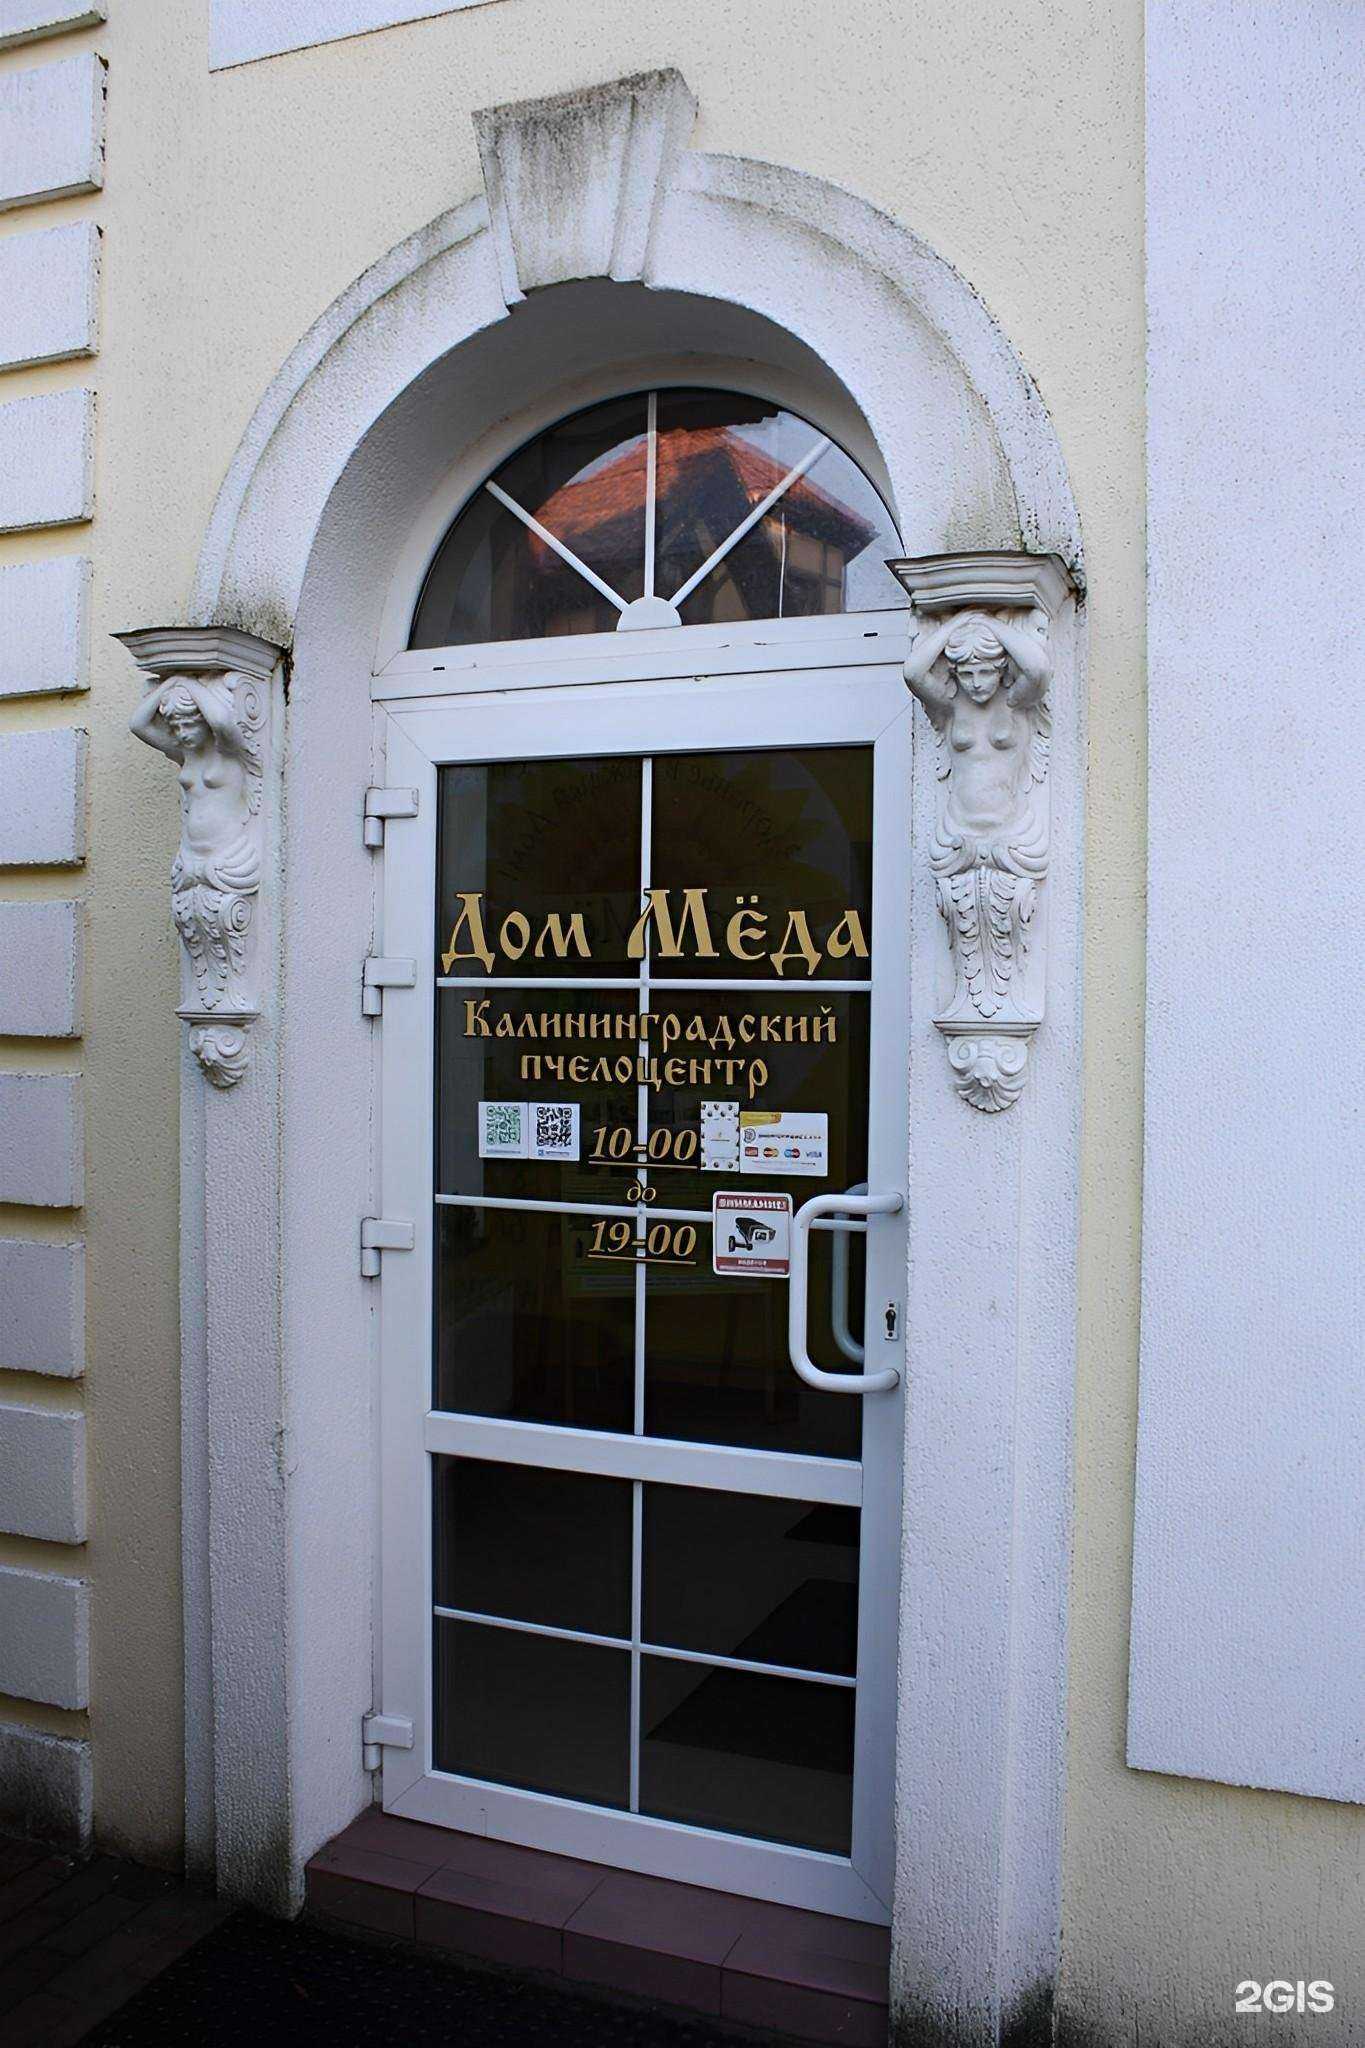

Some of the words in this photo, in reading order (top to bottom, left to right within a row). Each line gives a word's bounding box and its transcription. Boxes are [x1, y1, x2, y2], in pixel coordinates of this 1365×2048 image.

[442, 893, 592, 974] Дом
[627, 888, 869, 976] Мёда
[464, 999, 837, 1053] Калининградский
[521, 1054, 769, 1099] пчелоцентр
[591, 1126, 698, 1161] 10-00
[626, 1180, 657, 1203] до
[590, 1220, 698, 1258] 19-00
